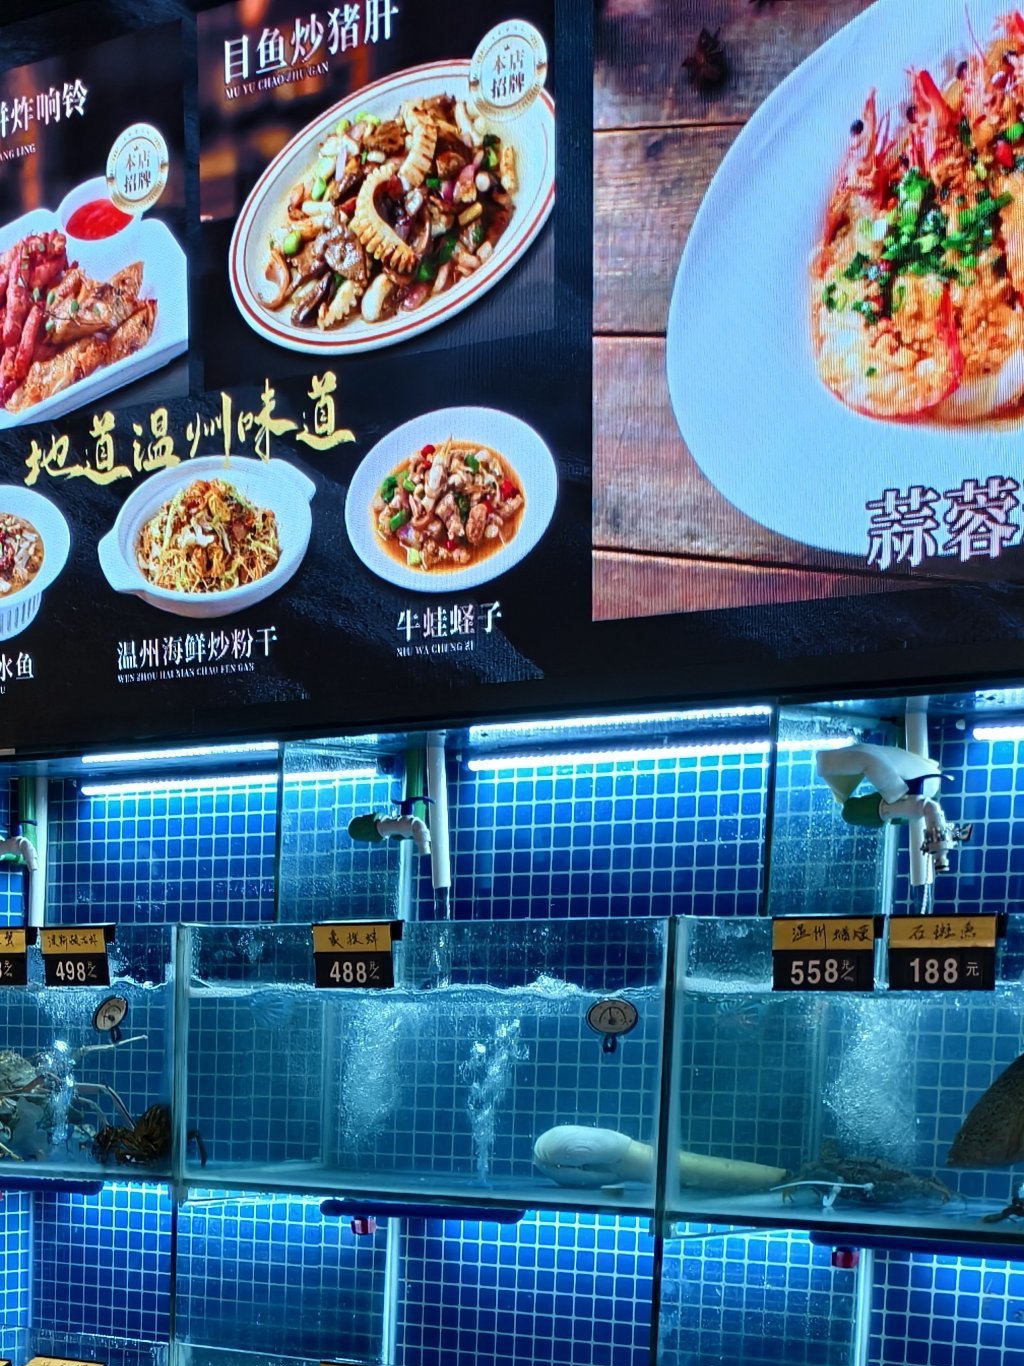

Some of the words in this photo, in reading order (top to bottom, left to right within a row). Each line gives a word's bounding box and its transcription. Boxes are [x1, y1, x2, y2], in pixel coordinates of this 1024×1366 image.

[224, 0, 398, 84] 目鱼炒猪肝
[493, 50, 524, 72] 本店
[242, 82, 256, 94] YU
[491, 75, 525, 99] 招牌
[124, 170, 152, 193] 招牌
[23, 372, 356, 486] 地道温州味道
[865, 474, 1024, 571] 蒜蓉
[396, 600, 502, 642] 牛蛙蛏子
[117, 625, 278, 671] 温州海鲜炒粉干
[415, 644, 430, 655] WA
[908, 920, 977, 941] 石斑鱼
[56, 961, 86, 982] 498
[329, 961, 367, 983] 488
[790, 958, 839, 985] 558
[909, 957, 958, 984] 188
